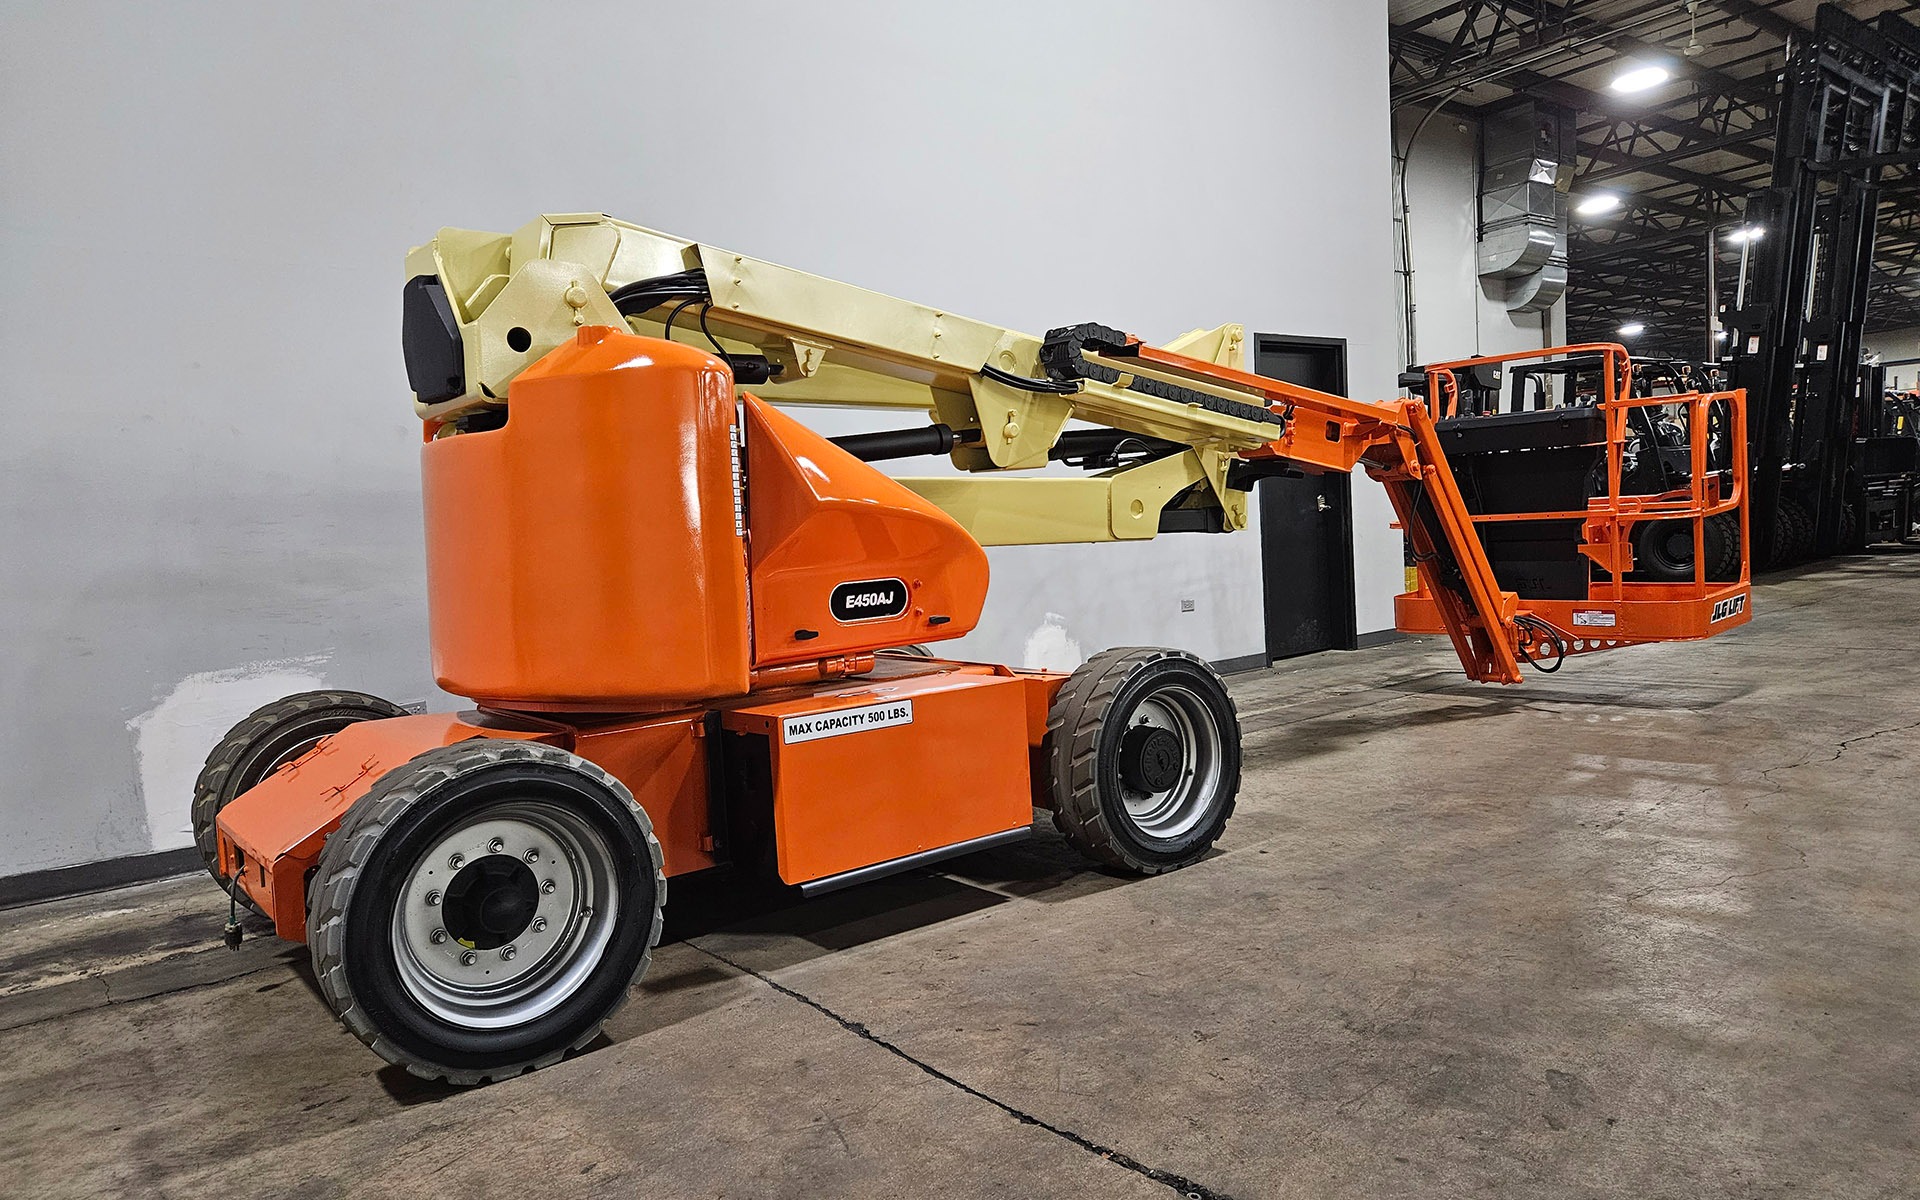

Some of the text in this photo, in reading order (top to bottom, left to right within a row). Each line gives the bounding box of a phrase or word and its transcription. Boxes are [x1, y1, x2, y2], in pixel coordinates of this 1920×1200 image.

[845, 591, 894, 609] E450AJ
[1711, 593, 1746, 623] JLG LIFT
[789, 707, 909, 736] MAX CAPACITY 500 LBS.
